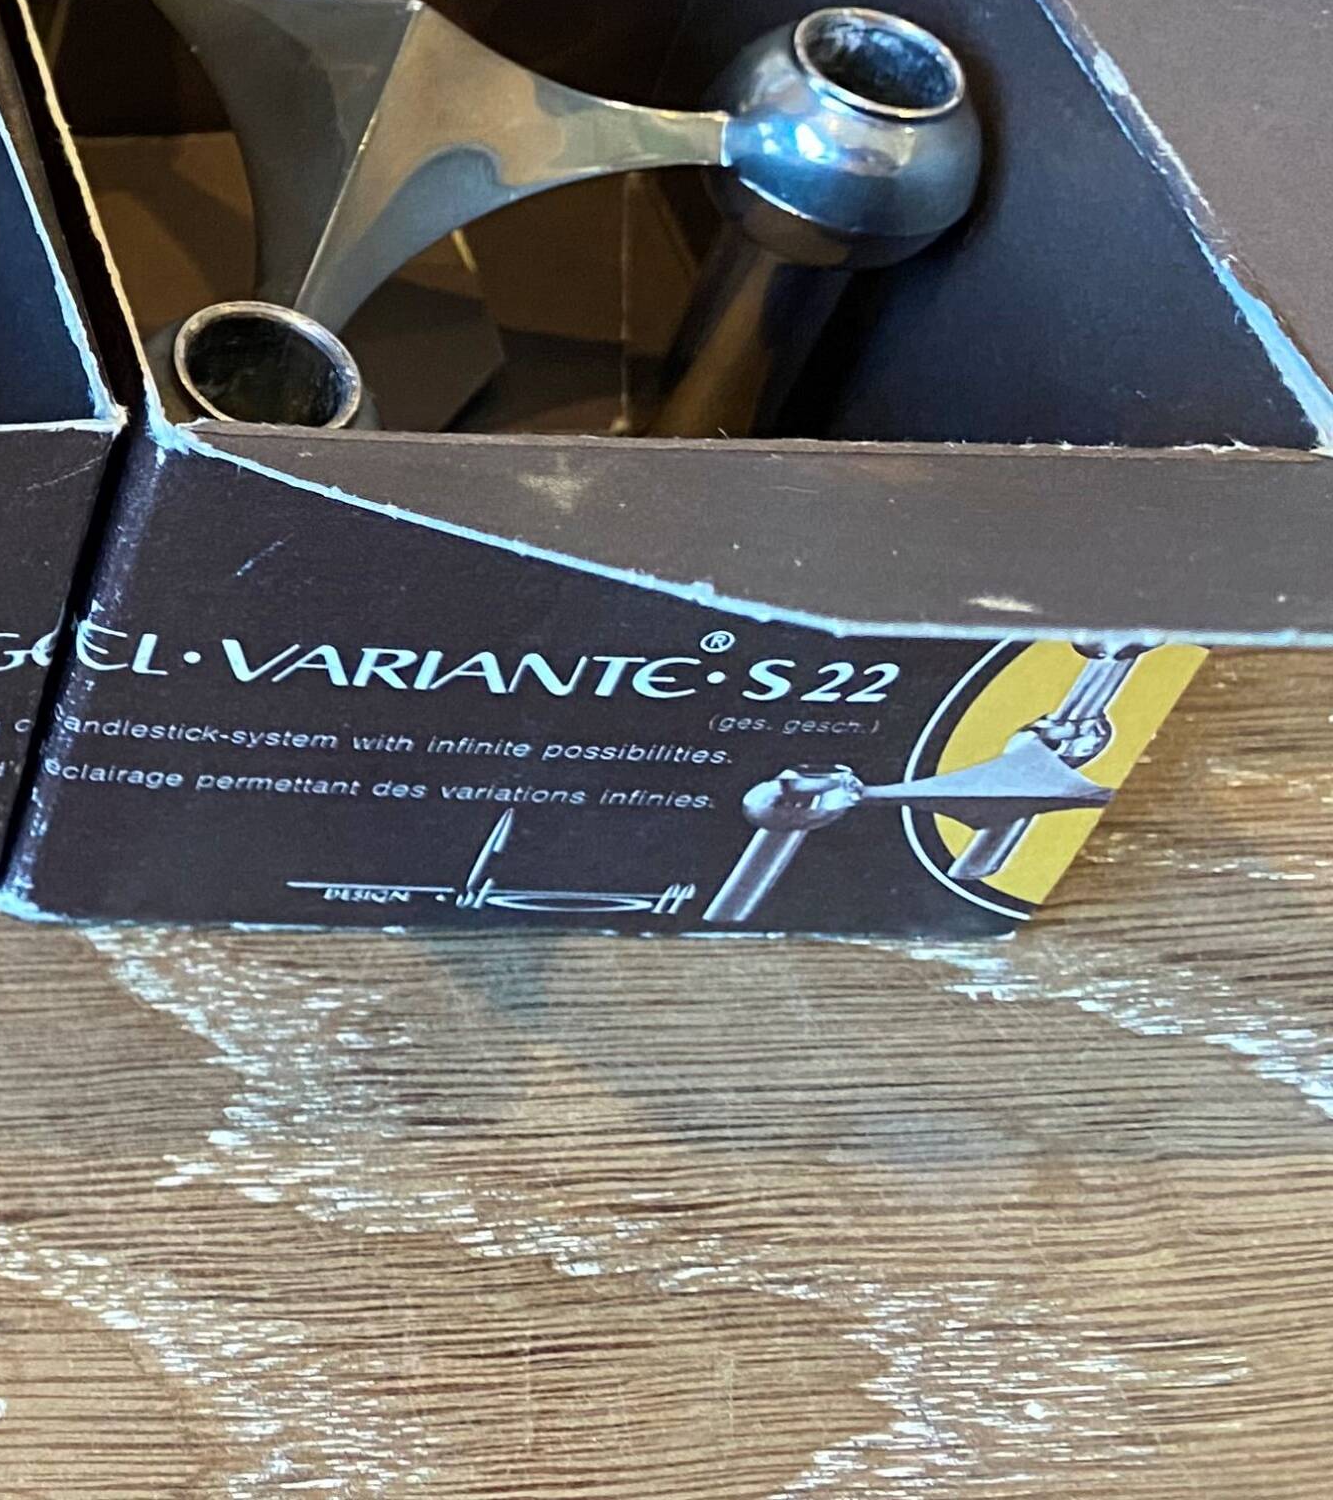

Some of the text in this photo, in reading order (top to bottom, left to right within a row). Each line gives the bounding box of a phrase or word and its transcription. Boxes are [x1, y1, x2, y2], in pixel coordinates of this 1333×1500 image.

[741, 658, 797, 701] S
[799, 661, 901, 703] 22
[351, 734, 416, 754] with
[426, 735, 533, 758] infinite
[540, 741, 733, 766] possibilities.
[195, 772, 362, 796] permettant
[371, 779, 428, 799] des
[439, 782, 587, 805] variations
[598, 787, 717, 810] infinies.
